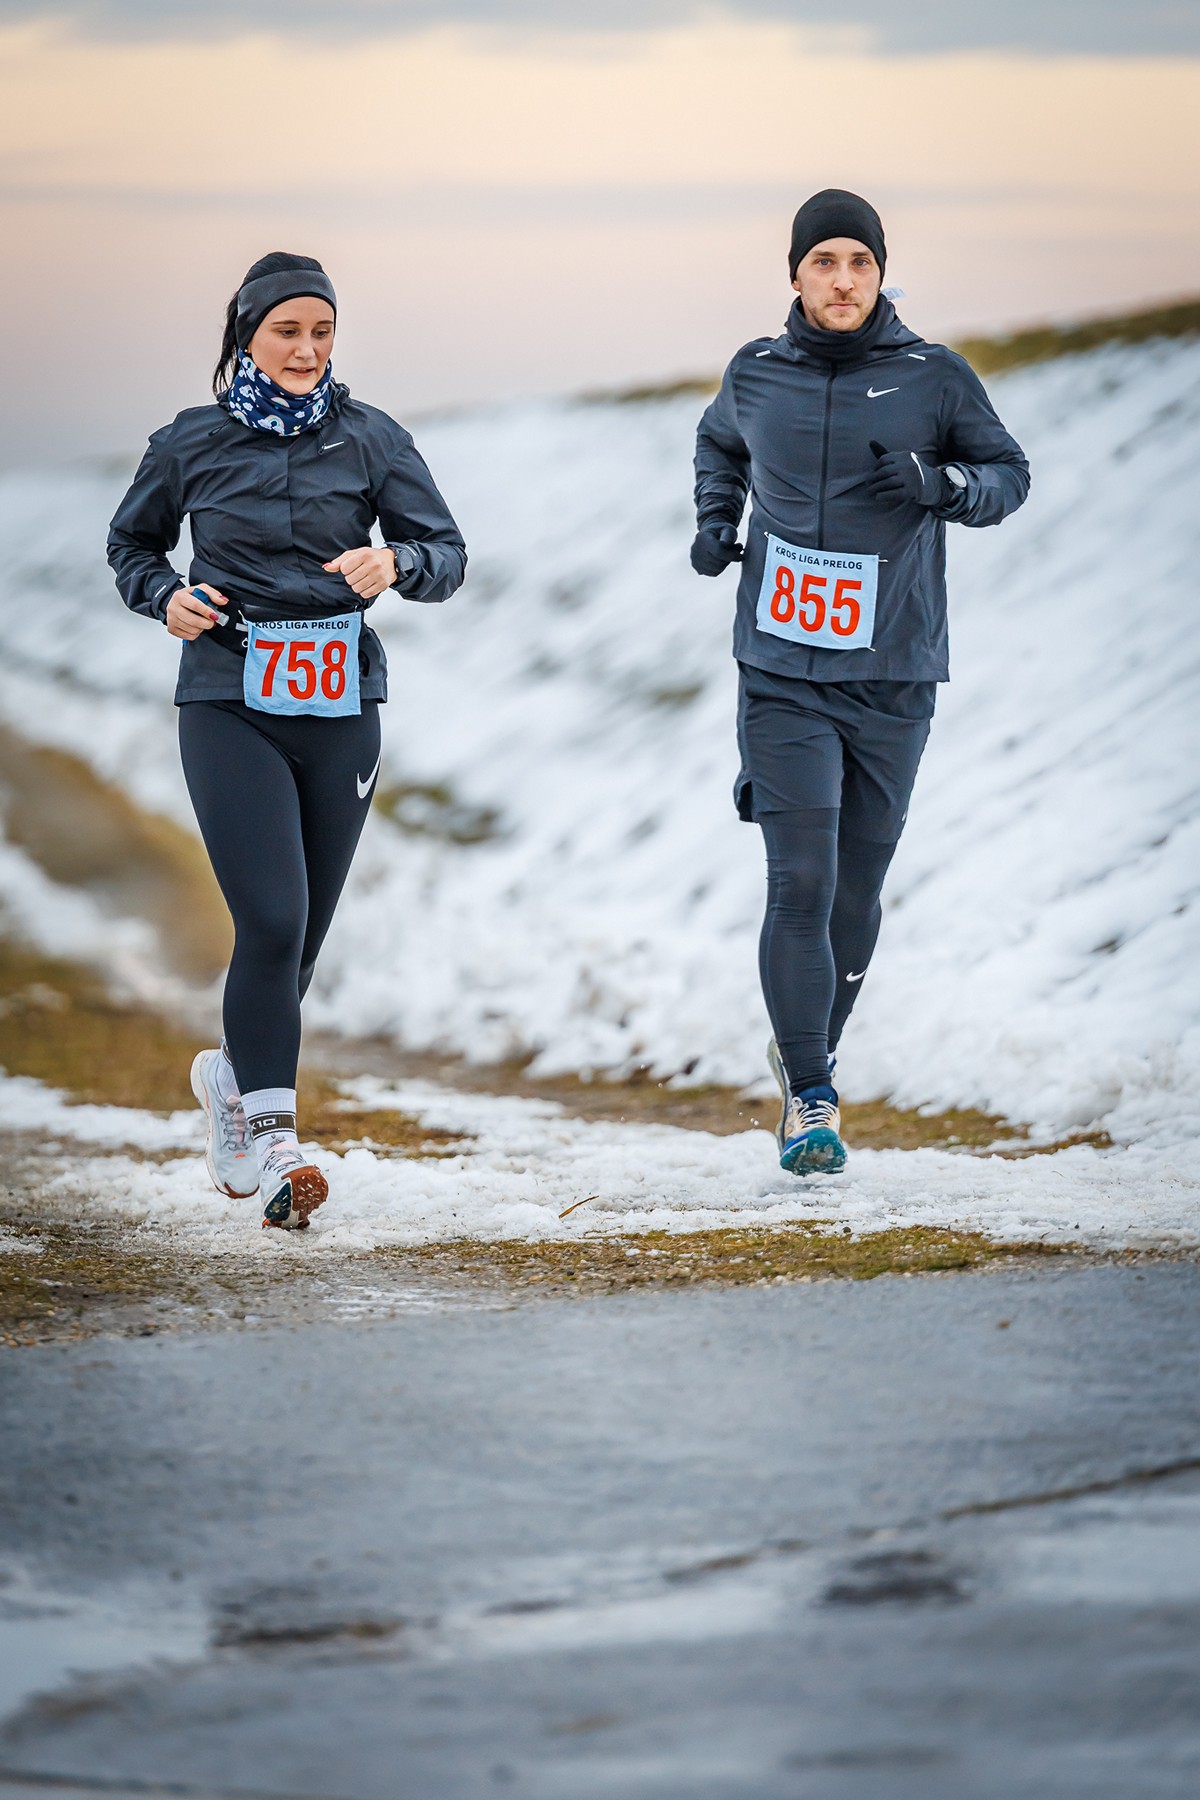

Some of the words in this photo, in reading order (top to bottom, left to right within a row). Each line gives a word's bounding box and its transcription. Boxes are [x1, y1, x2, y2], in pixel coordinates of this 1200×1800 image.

[775, 545, 797, 560] KROS
[798, 554, 820, 566] LIGA
[823, 559, 862, 570] PRELOG
[770, 565, 862, 636] 855
[255, 621, 282, 629] KROS
[286, 621, 309, 629] LIGA
[311, 620, 349, 629] PRELOG
[255, 639, 347, 700] 758
